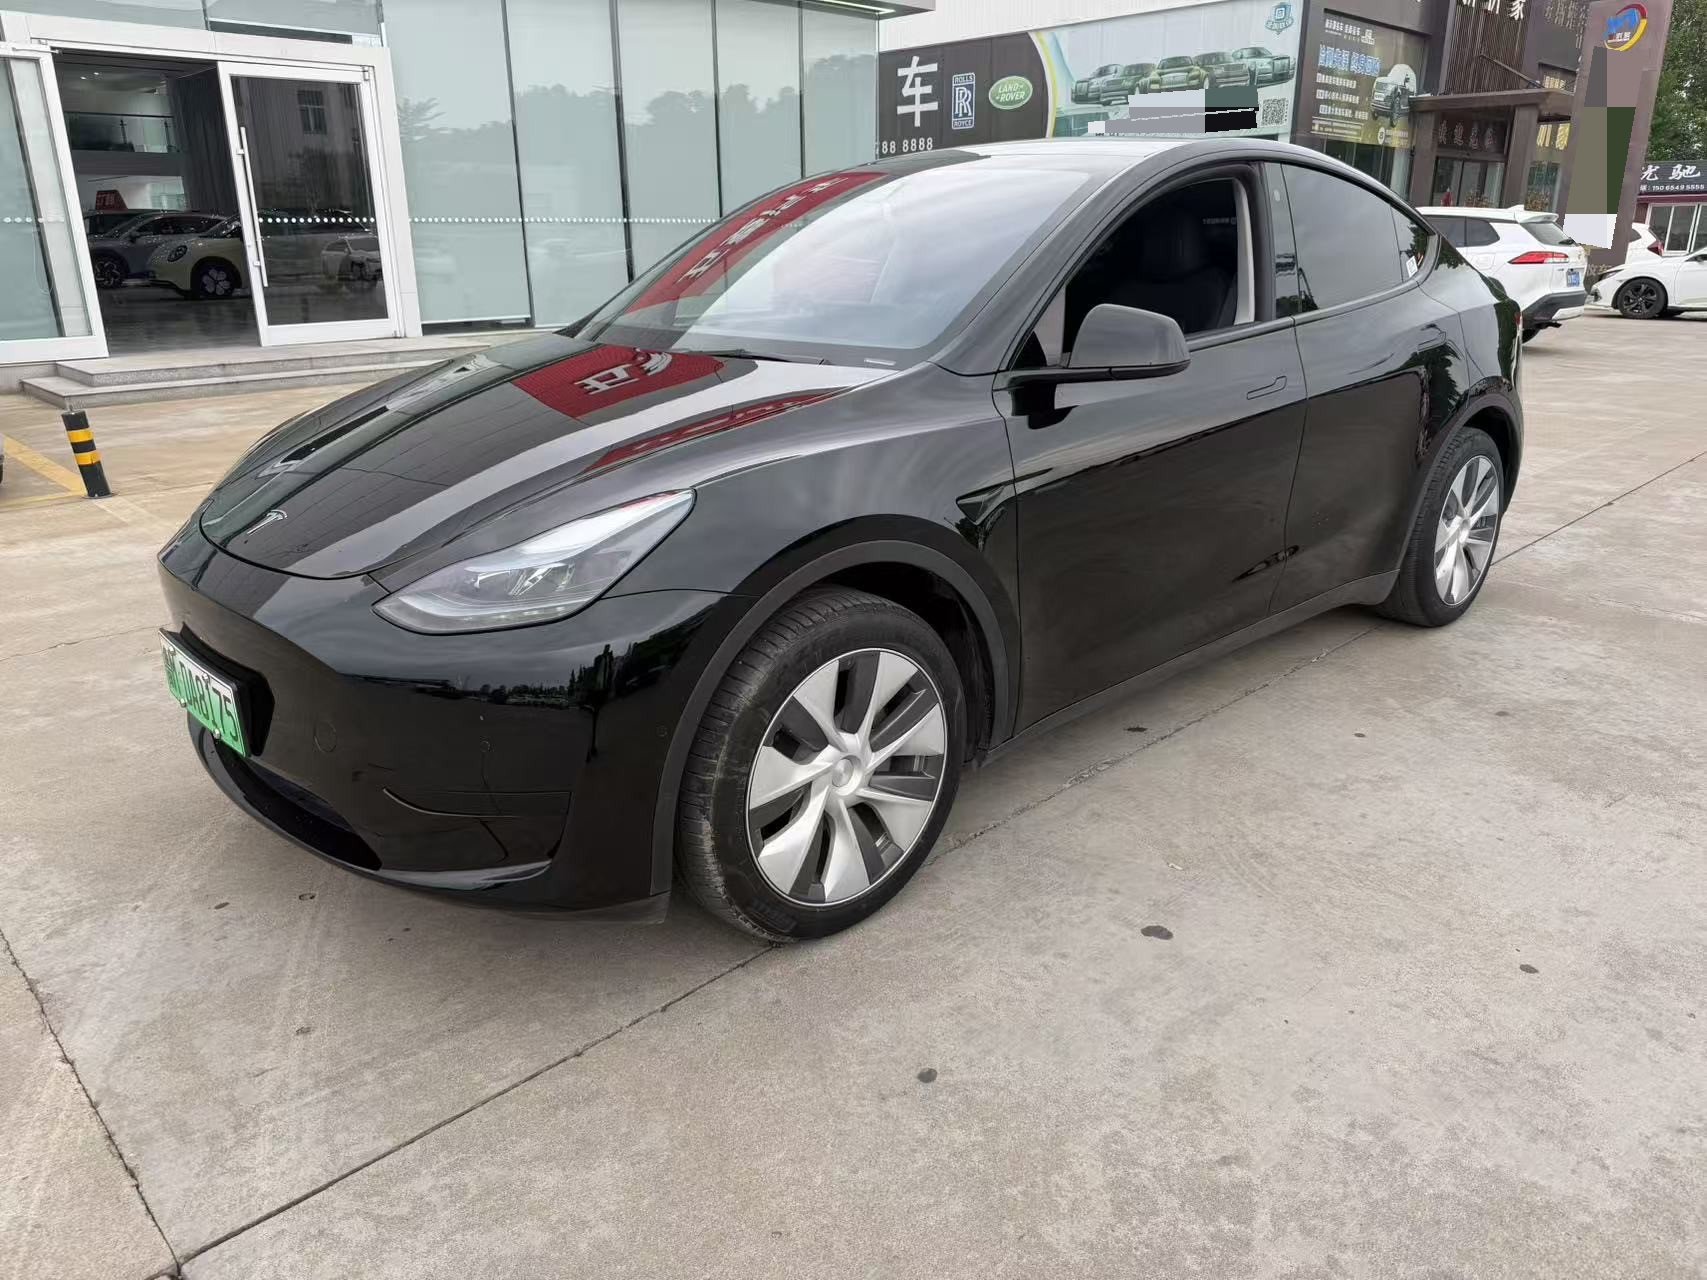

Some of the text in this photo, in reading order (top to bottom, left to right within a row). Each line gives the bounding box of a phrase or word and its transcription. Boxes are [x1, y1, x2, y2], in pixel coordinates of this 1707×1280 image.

[954, 75, 974, 84] ROLLS
[897, 55, 938, 128] 车
[953, 119, 972, 128] ROYCE
[902, 137, 933, 153] 8888
